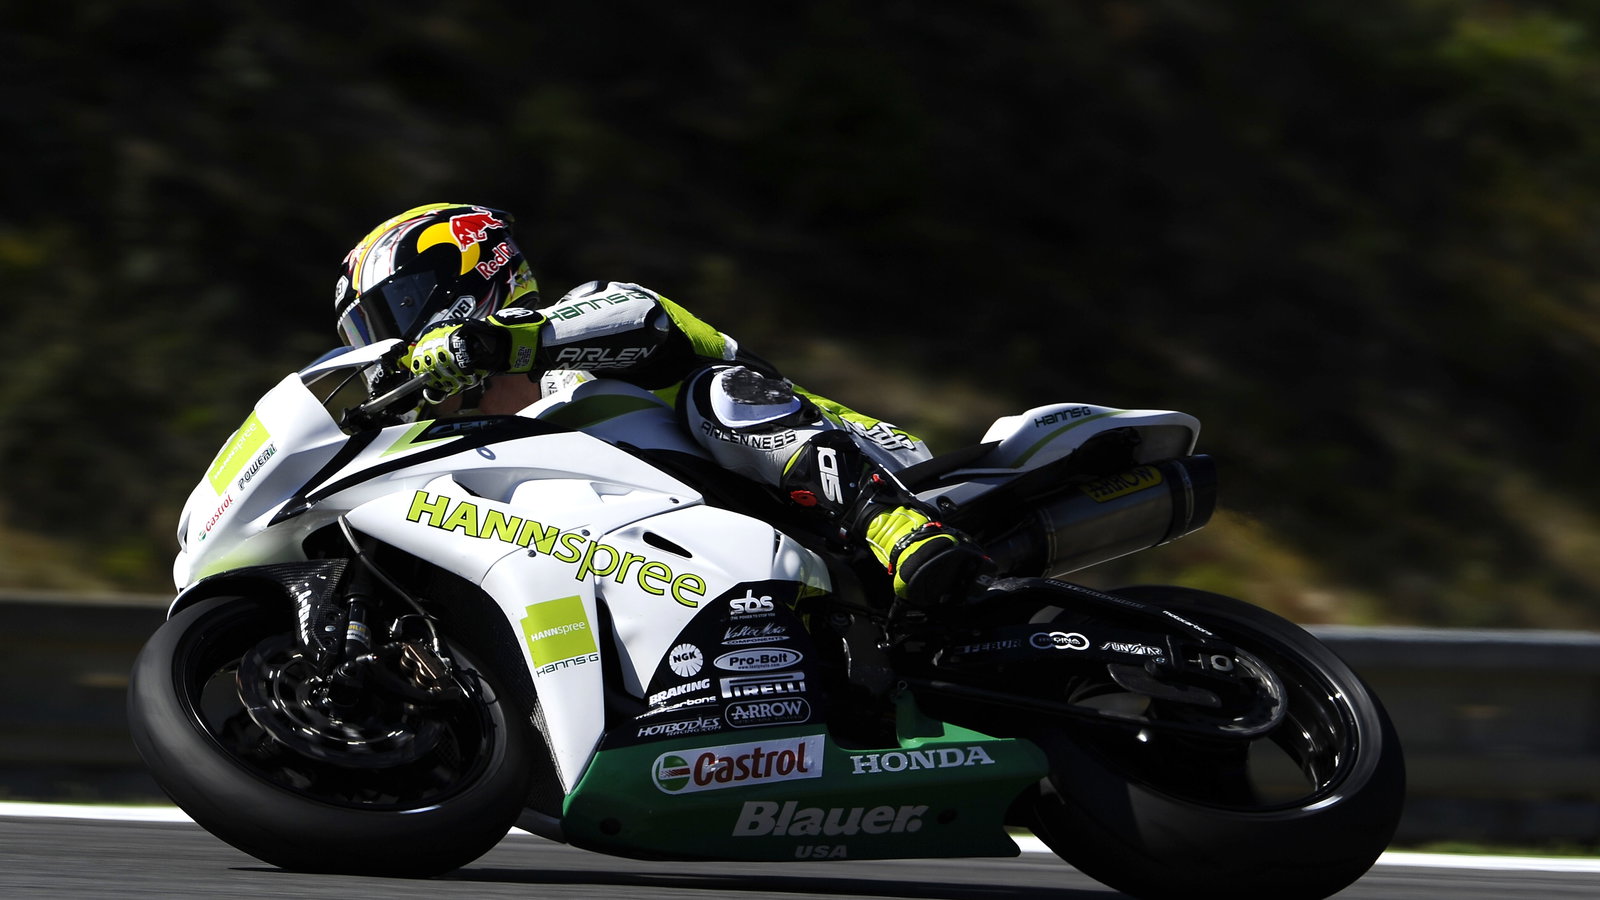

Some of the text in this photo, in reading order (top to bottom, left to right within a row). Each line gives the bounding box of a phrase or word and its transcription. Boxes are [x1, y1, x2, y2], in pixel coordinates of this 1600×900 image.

[449, 300, 472, 322] OEI
[555, 344, 657, 362] ARLEN
[701, 421, 797, 449] ARLEN NESS
[205, 494, 233, 532] Castrol
[406, 490, 707, 608] HANNspree
[730, 589, 774, 614] sbs
[530, 620, 586, 642] HANNspree
[673, 650, 697, 663] NGK
[730, 653, 787, 666] Pro-Bolt
[1100, 642, 1162, 656] SUNSTAR
[649, 678, 710, 705] BRAKING
[720, 671, 806, 699] PIRELLI
[731, 701, 802, 720] ARROW
[637, 717, 720, 737] HOTBODIES
[693, 742, 808, 787] Castrol
[850, 746, 995, 774] HONDA
[795, 845, 847, 858] USA
